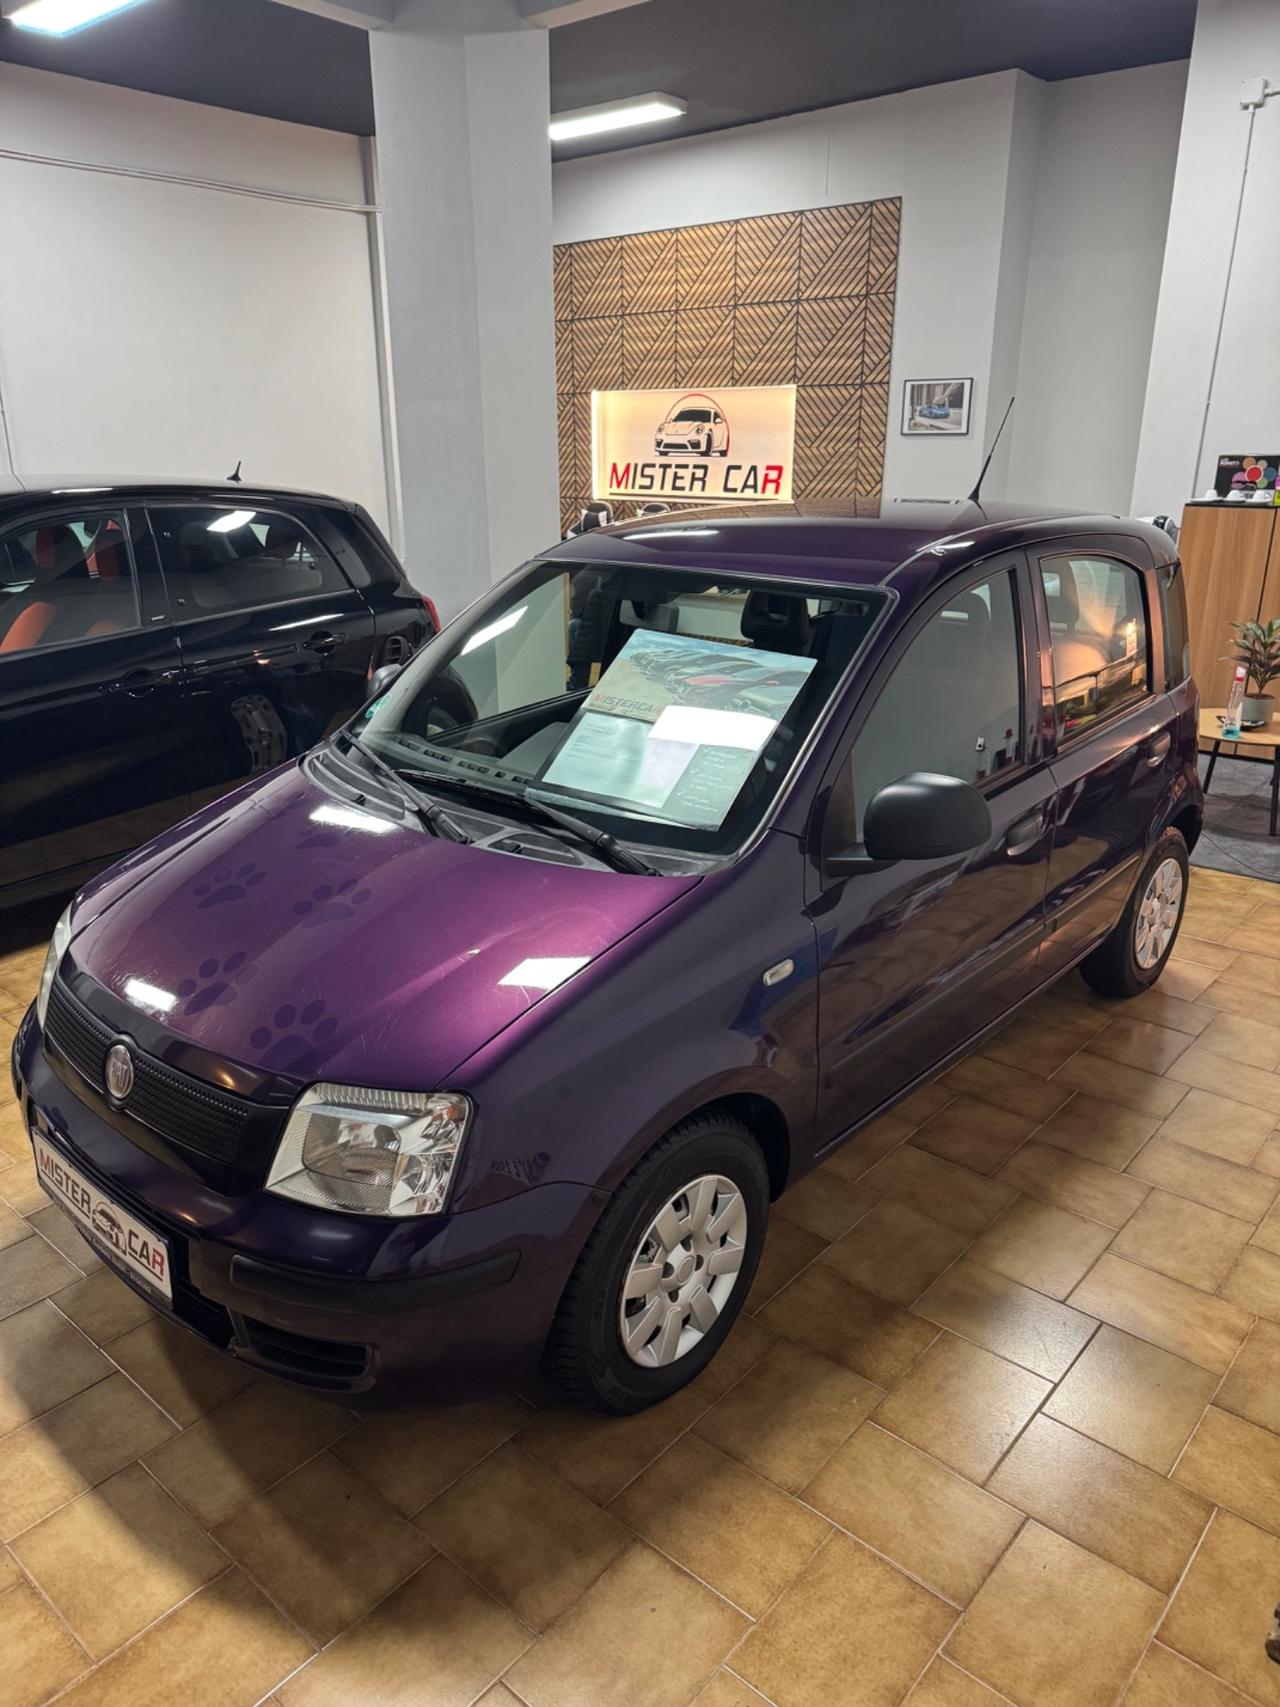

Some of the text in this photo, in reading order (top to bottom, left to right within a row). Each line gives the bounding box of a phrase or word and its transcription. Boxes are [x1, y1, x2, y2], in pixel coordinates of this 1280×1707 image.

[609, 462, 784, 495] MISTER CAR
[111, 1057, 129, 1090] FIAT
[39, 1147, 92, 1215] MISTER
[127, 1228, 165, 1278] CAR
